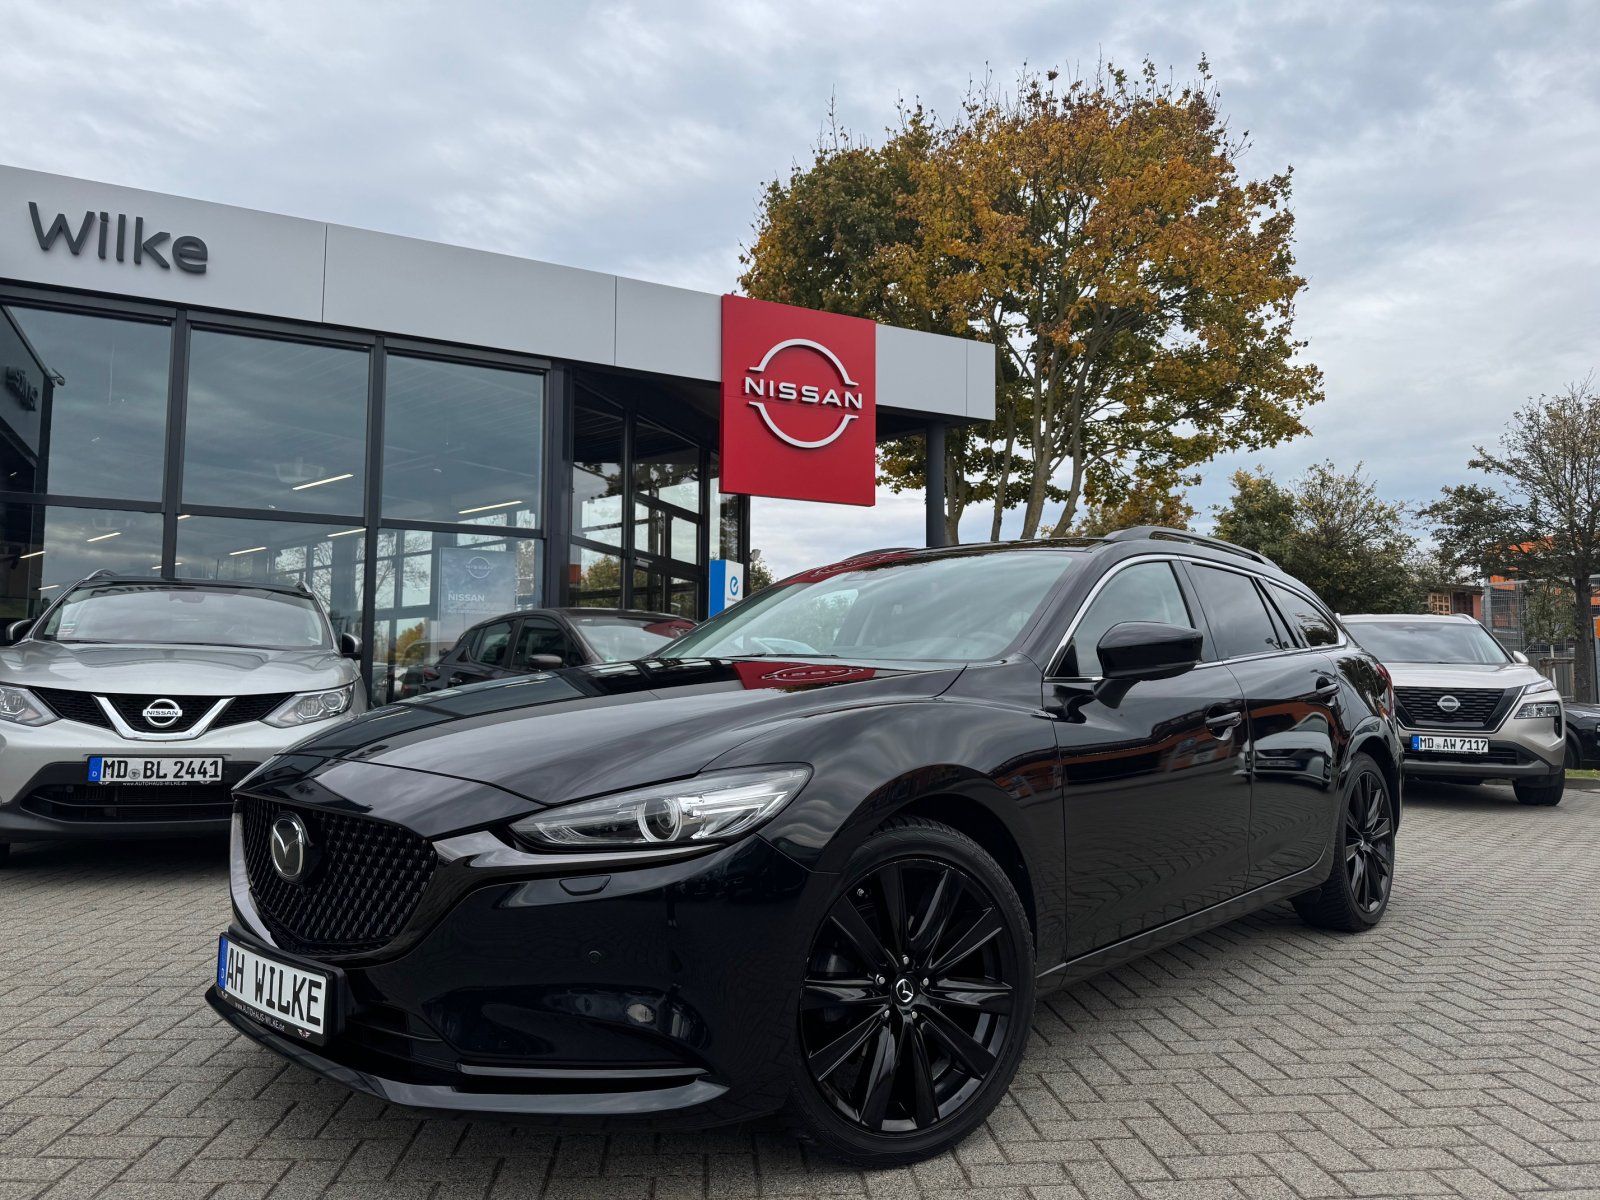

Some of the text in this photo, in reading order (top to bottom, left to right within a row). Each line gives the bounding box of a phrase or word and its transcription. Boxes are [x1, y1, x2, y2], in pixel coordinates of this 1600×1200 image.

[28, 201, 208, 274] Wilke
[744, 376, 863, 409] NISSAN
[448, 593, 485, 602] NISSAN
[1420, 738, 1487, 750] MD AW 7117
[103, 760, 219, 779] MD BL 2441
[227, 948, 322, 1027] AH WILKE
